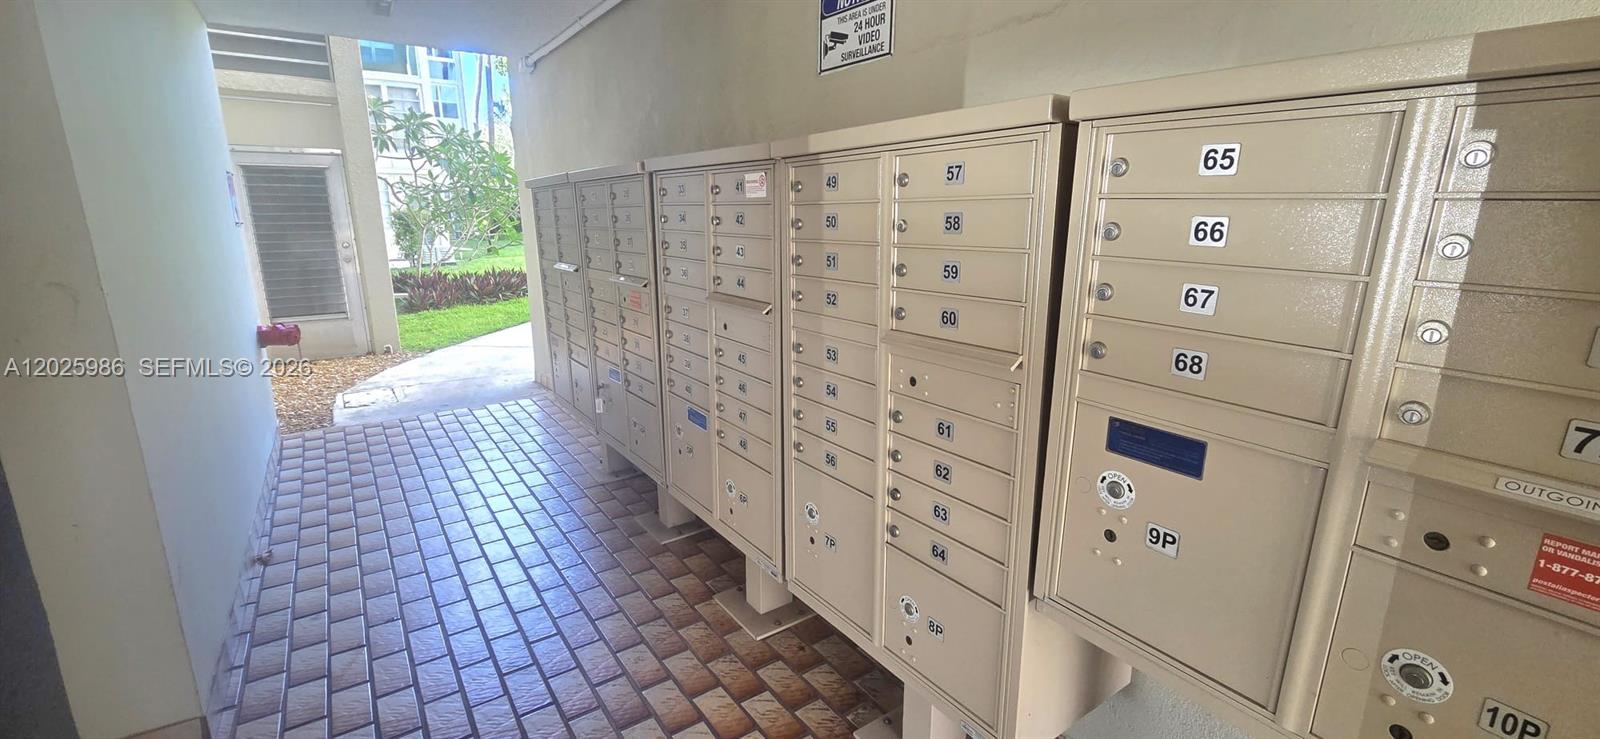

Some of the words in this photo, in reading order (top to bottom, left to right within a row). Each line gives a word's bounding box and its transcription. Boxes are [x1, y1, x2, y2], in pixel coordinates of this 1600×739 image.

[837, 14, 848, 25] THIS
[849, 11, 862, 21] AREA
[862, 7, 868, 16] IS
[868, 2, 886, 15] UNDER
[854, 20, 863, 33] 24
[864, 13, 886, 30] HOUR
[858, 29, 880, 46] VIDEO
[841, 41, 885, 62] SURVEILLANCE
[1203, 148, 1236, 170] 65
[946, 165, 962, 181] 57
[735, 181, 744, 192] 41
[825, 176, 837, 189] 49
[735, 214, 744, 225] 42
[825, 216, 837, 228] 50
[944, 216, 960, 231] 58
[1193, 221, 1225, 243] 66
[736, 247, 744, 257] 43
[826, 256, 836, 268] 51
[943, 264, 958, 279] 59
[736, 278, 745, 288] 44
[826, 293, 837, 305] 52
[1183, 287, 1215, 309] 67
[941, 311, 957, 326] 60
[826, 348, 837, 362] 53
[1174, 352, 1203, 375] 68
[825, 384, 836, 397] 54
[825, 419, 836, 433] 55
[937, 421, 951, 438] 61
[825, 453, 836, 467] 56
[935, 464, 950, 481] 62
[1107, 472, 1127, 484] OPEN
[933, 505, 948, 522] 63
[824, 535, 836, 549] 7P
[1148, 527, 1177, 549] 9P
[1544, 538, 1580, 553] REPORT
[931, 544, 946, 562] 64
[1542, 545, 1555, 554] OR
[928, 620, 943, 636] 8P
[1401, 651, 1439, 671] OPEN
[1486, 706, 1541, 739] 10P
